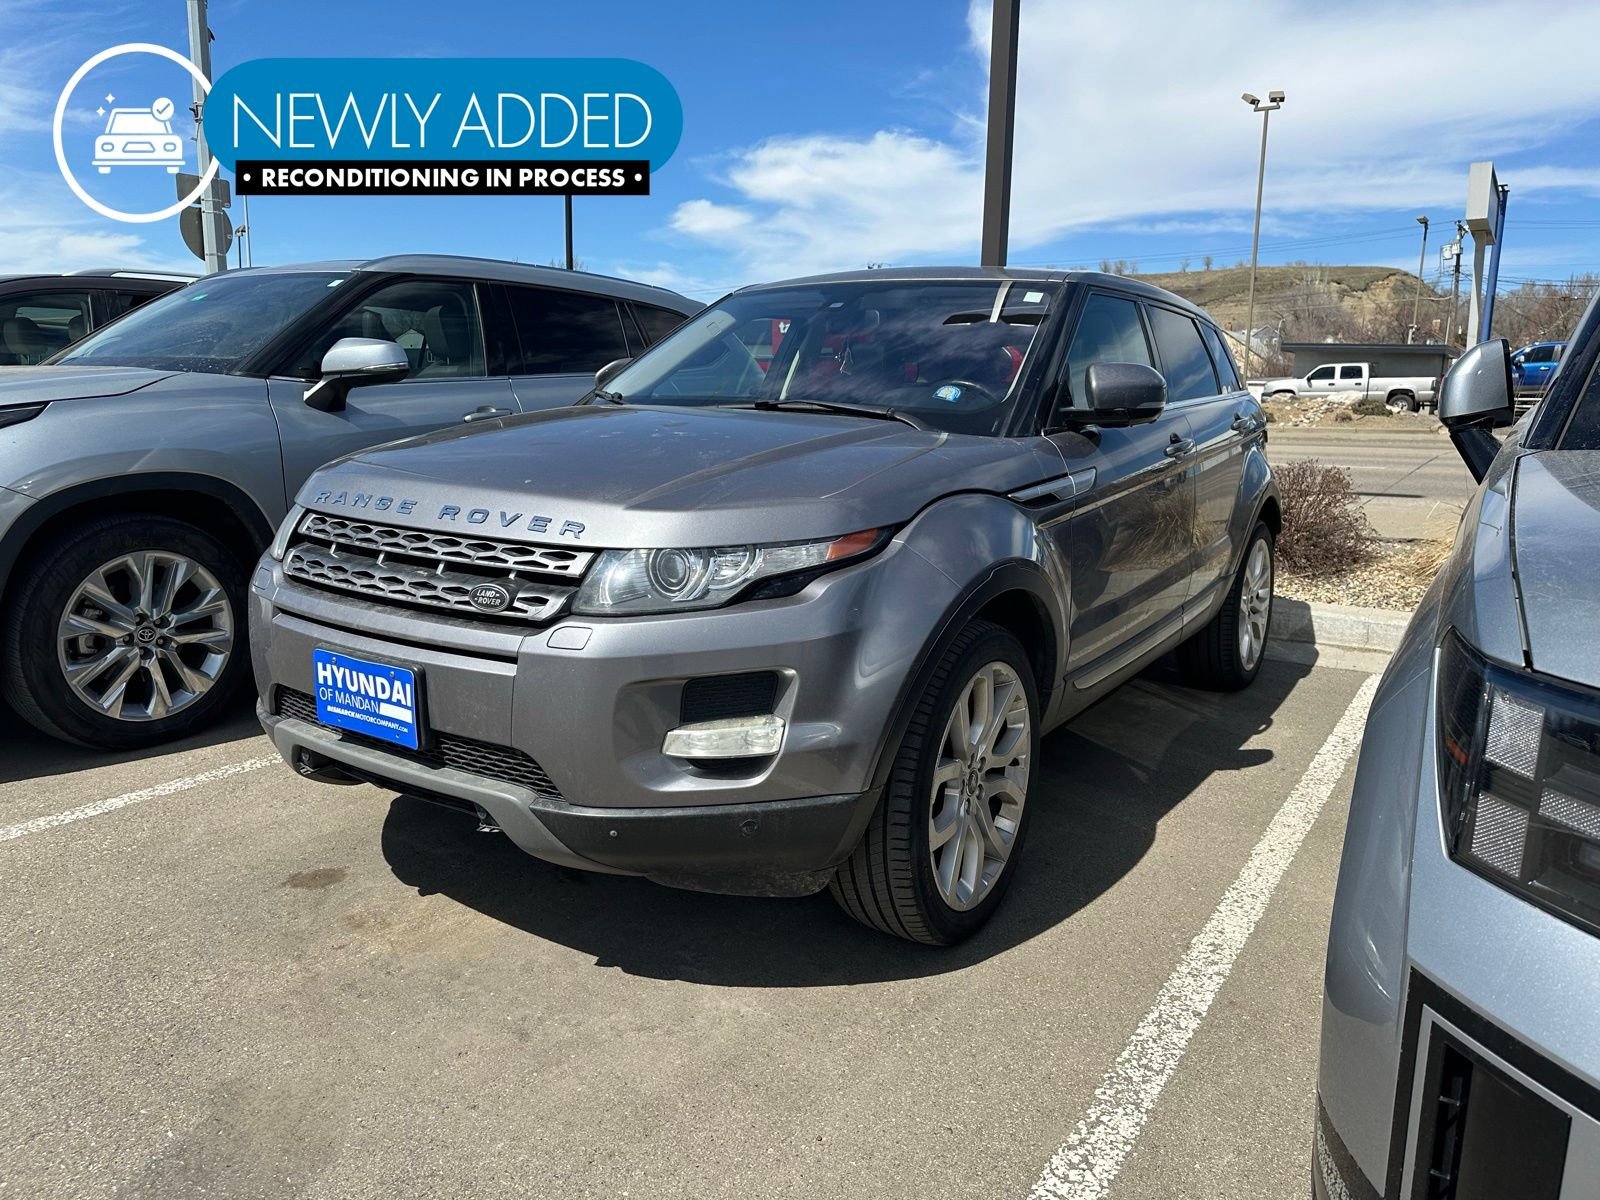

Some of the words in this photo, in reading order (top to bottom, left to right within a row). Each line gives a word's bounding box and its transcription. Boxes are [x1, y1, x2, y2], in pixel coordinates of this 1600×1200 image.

[313, 490, 417, 515] RANGE
[437, 504, 586, 540] ROVER
[317, 662, 411, 707] HYUNDAI
[319, 687, 333, 701] OF
[335, 690, 379, 714] MANDAN
